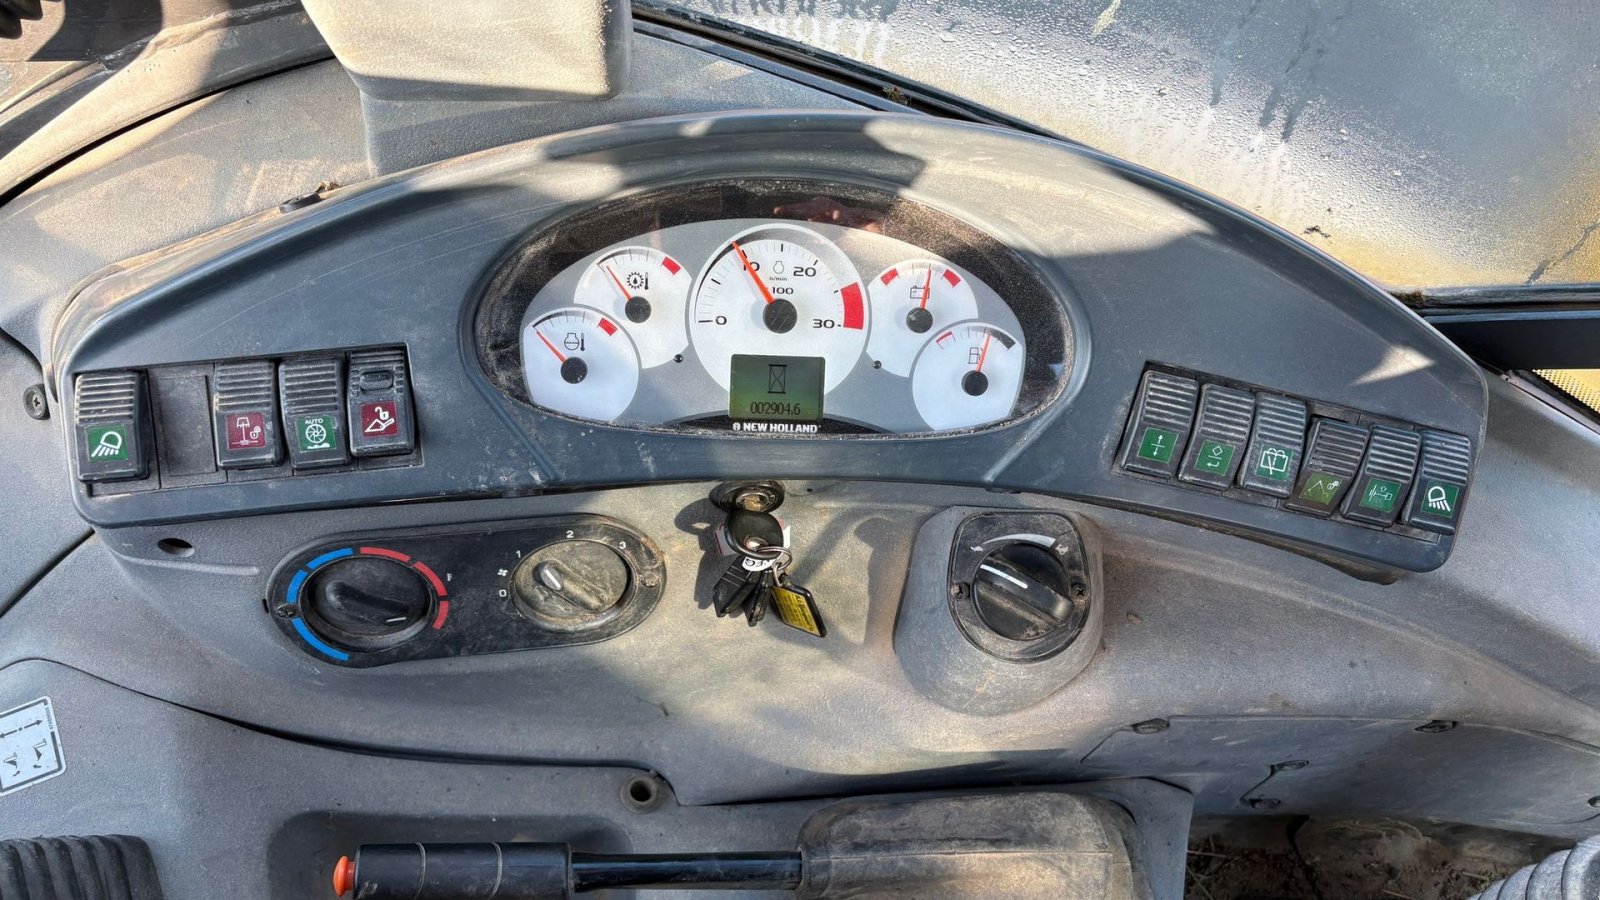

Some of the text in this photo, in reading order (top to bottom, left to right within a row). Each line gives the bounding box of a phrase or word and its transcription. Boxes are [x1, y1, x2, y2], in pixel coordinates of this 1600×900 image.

[793, 267, 817, 277] 20
[772, 287, 794, 295] 100
[715, 316, 727, 325] 0
[813, 318, 835, 329] 30
[750, 401, 801, 415] 002904.6
[743, 422, 818, 434] NEW HOLLAND
[566, 530, 574, 538] 2
[619, 541, 627, 549] 3
[516, 550, 522, 558] 1
